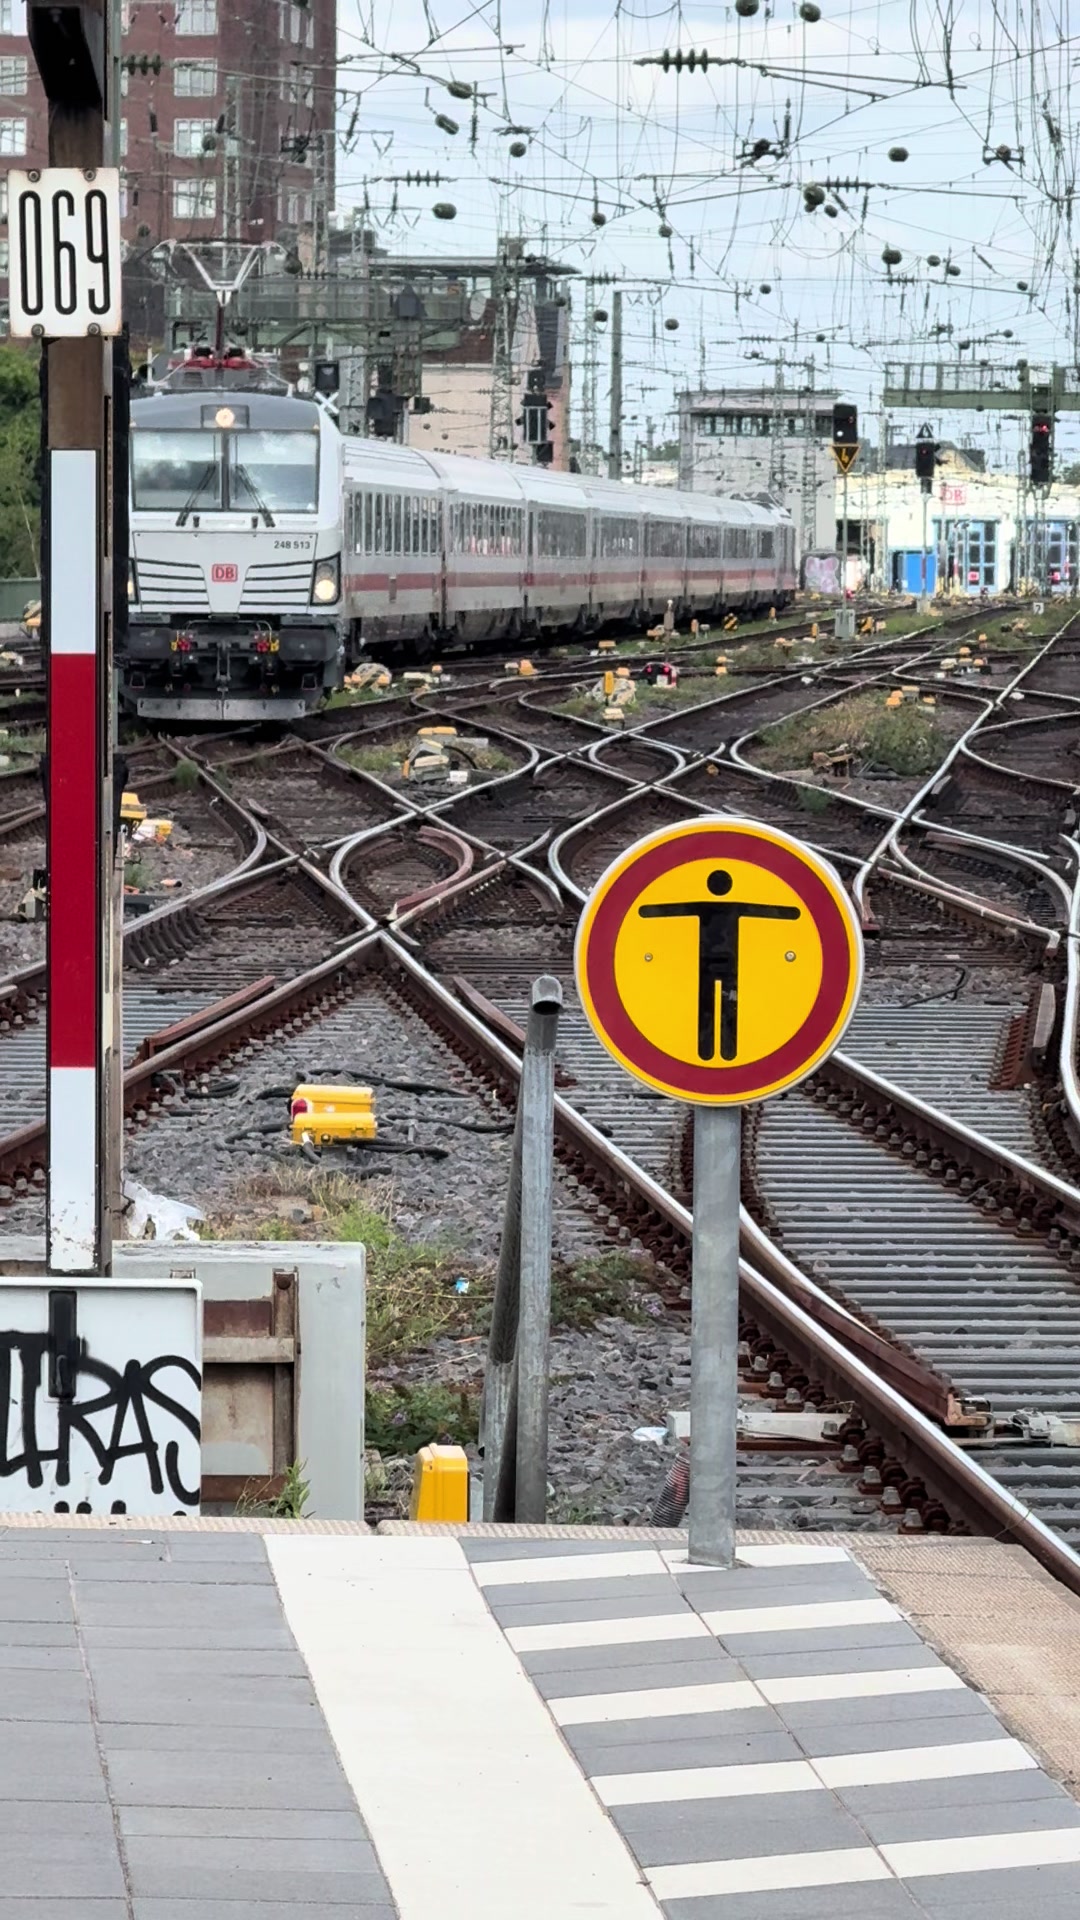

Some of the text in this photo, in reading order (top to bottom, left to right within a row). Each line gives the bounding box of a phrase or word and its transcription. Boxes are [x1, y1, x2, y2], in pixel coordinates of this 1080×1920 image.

[18, 189, 111, 316] 069
[943, 488, 964, 502] DB
[274, 540, 311, 550] 248 513
[214, 566, 236, 580] DB
